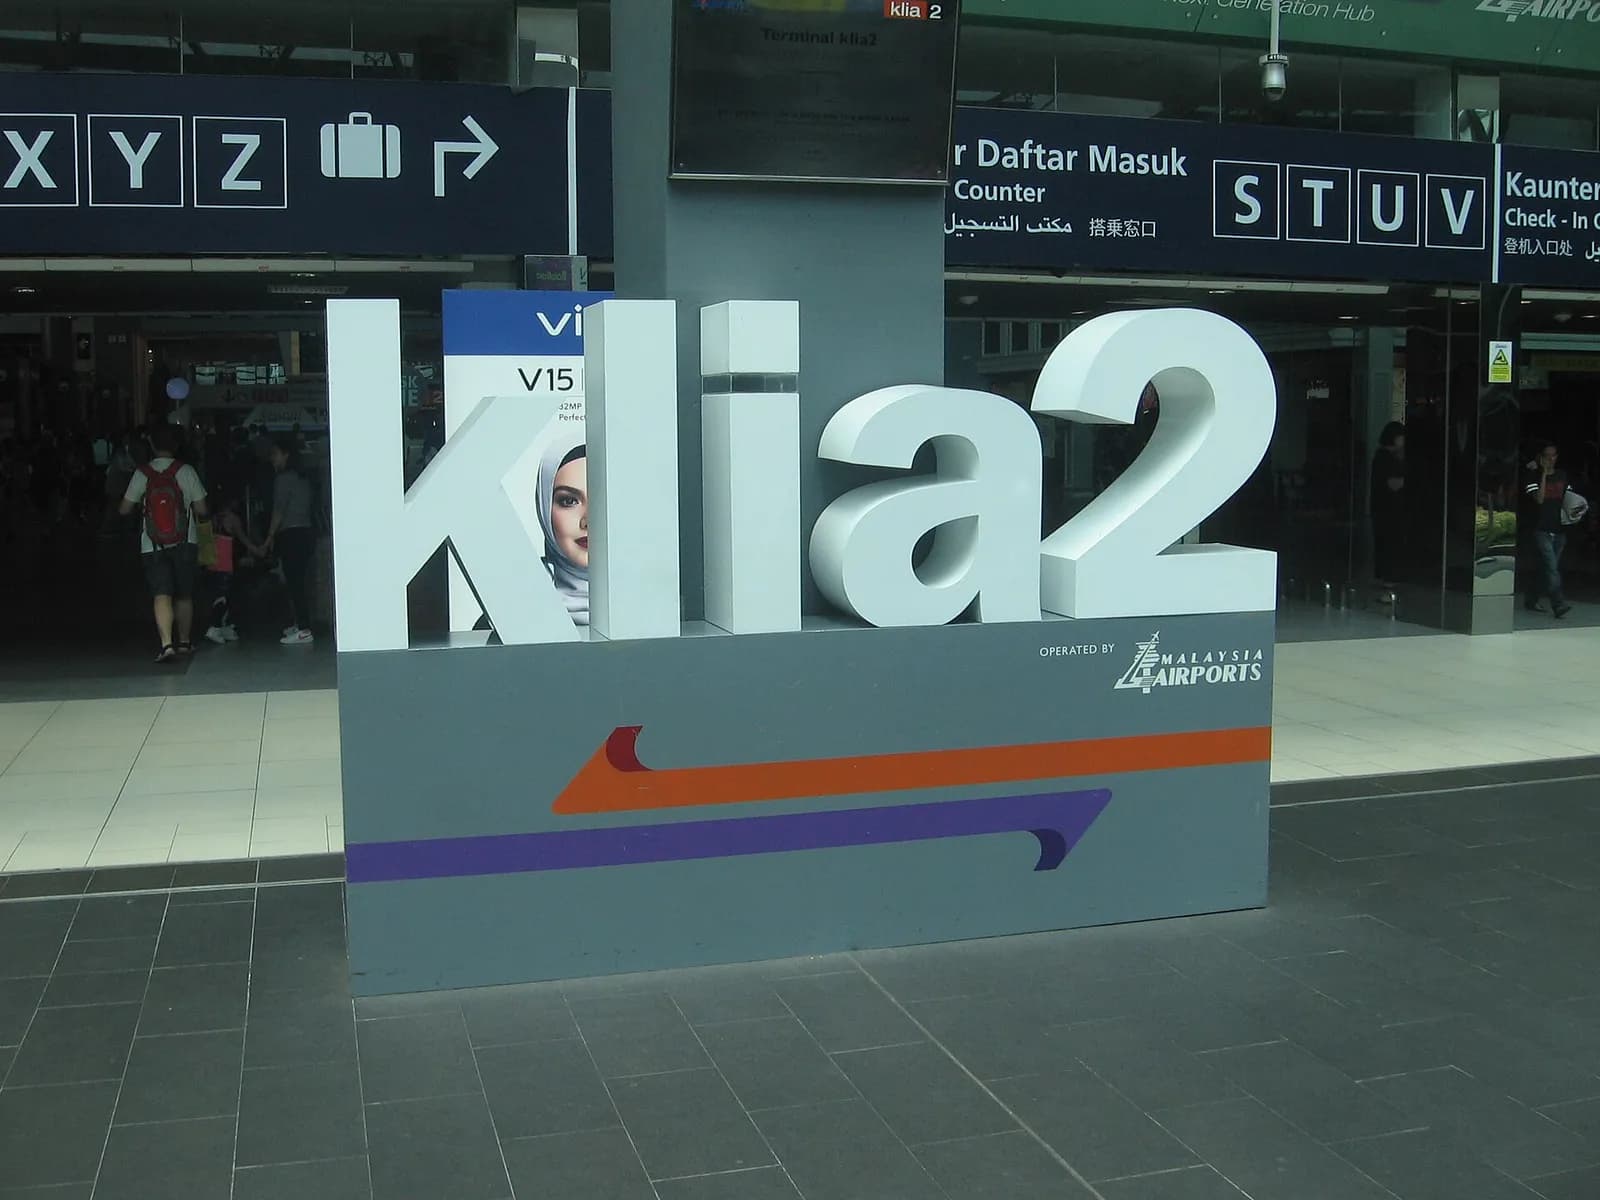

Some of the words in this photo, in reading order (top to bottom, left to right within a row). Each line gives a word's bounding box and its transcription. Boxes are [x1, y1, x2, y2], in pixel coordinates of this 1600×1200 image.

[890, 2, 921, 18] klia
[929, 5, 942, 19] 2
[1332, 4, 1375, 22] Hub
[763, 27, 834, 45] Terminal
[839, 31, 877, 47] klia2
[3, 130, 58, 189] X
[108, 131, 162, 189] Y
[221, 133, 262, 191] Z
[978, 139, 1079, 172] Daftar
[1089, 144, 1188, 177] Masuk
[954, 179, 1046, 203] Counter
[1506, 171, 1600, 200] Kaunter
[1234, 175, 1262, 224] S
[1302, 179, 1334, 227] T
[1372, 184, 1404, 232] U
[1440, 188, 1475, 235] V
[944, 212, 1019, 238] التسجيل
[1026, 217, 1073, 234] مكتب
[1504, 207, 1557, 228] Check
[1573, 211, 1588, 229] In
[1504, 237, 1574, 256] 登机入口处
[517, 367, 574, 392] V15
[326, 298, 1278, 652] klia2
[1039, 645, 1097, 657] OPERATED
[1102, 643, 1115, 654] BY
[1160, 649, 1263, 665] MALAYSIA
[1151, 663, 1262, 688] AIRPORTS
